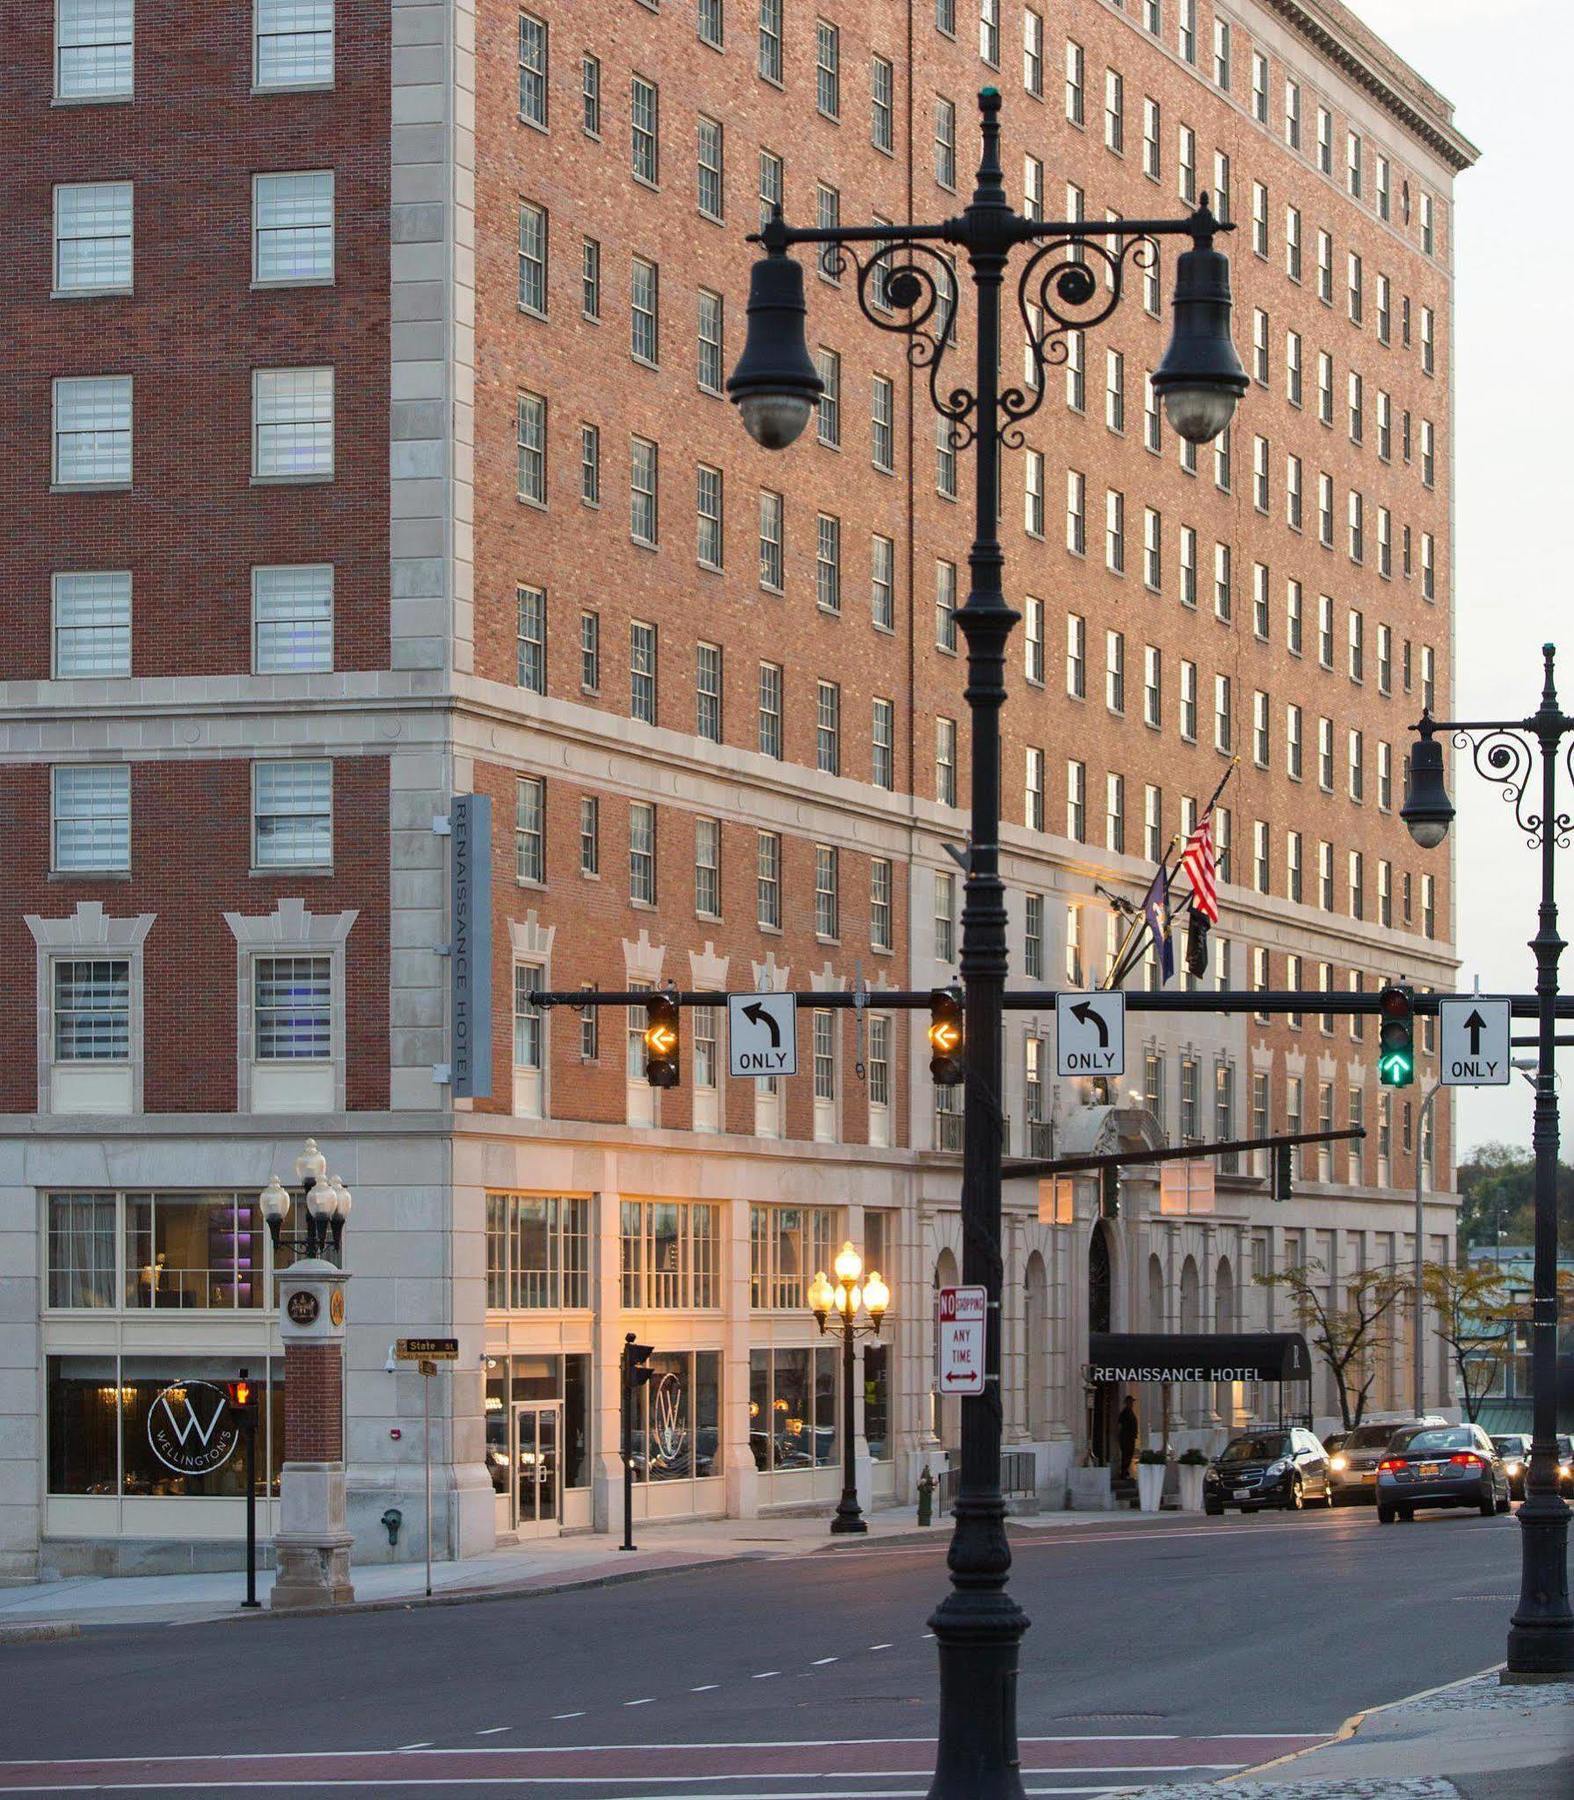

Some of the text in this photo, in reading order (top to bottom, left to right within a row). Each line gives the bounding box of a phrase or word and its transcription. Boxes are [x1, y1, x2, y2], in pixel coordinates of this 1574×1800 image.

[455, 803, 467, 1091] RENAISSANCE HOTEL
[740, 1053, 787, 1069] ONLY
[1067, 1053, 1115, 1069] ONLY
[1452, 1061, 1498, 1077] ONLY
[941, 1294, 955, 1315] NO
[954, 1330, 971, 1342] ANY
[410, 1341, 436, 1351] State
[952, 1350, 971, 1363] TIME
[1293, 1345, 1301, 1368] R
[1094, 1367, 1263, 1382] RENAISSANCE HOTEL
[161, 1398, 226, 1446] W
[157, 1430, 231, 1466] WELLINGTON'S
